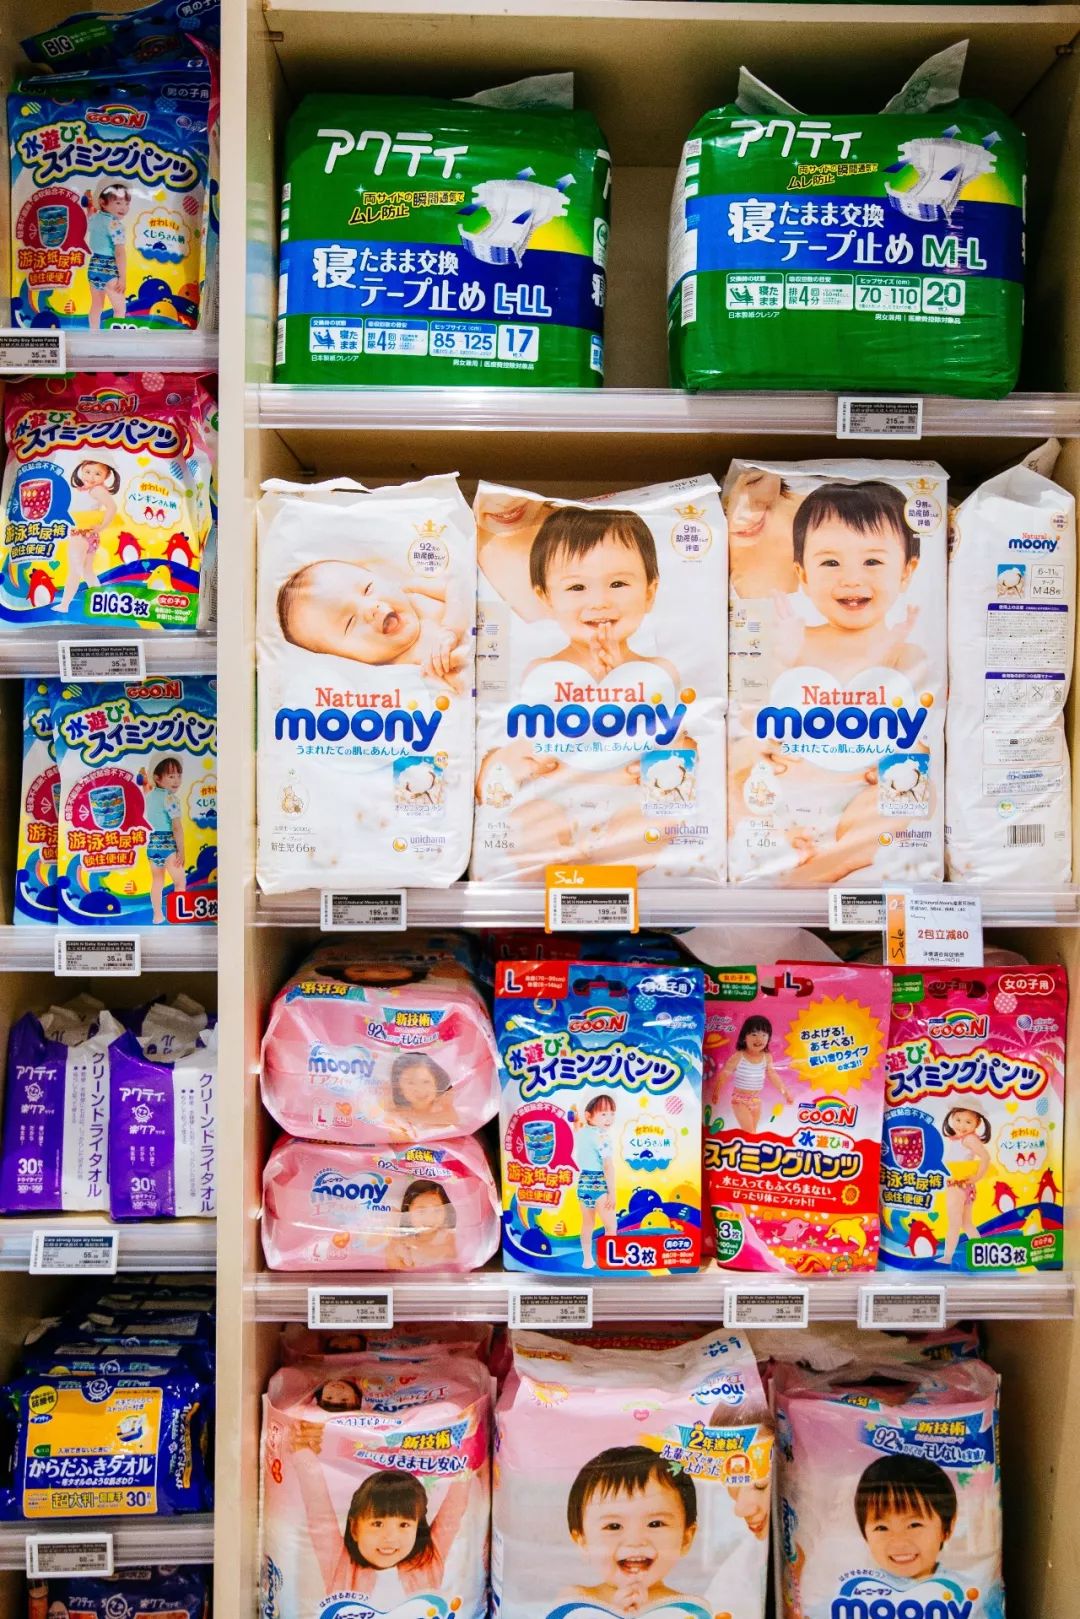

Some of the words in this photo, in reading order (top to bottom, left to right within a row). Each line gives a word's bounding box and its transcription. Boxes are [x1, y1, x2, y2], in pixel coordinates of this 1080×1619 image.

[730, 120, 864, 160] アクティ
[41, 145, 193, 183] スイミングパンツ
[316, 129, 469, 180] アクティ
[786, 174, 835, 190] ムレ防止
[348, 205, 411, 226] ムレ防止
[779, 231, 914, 265] テープ止め
[18, 249, 85, 270] 游泳纸尿裤
[359, 277, 486, 313] テープ止め
[926, 282, 962, 308] 20
[505, 327, 532, 354] 17
[23, 418, 178, 454] スイミングパンツ
[1008, 538, 1058, 552] moony
[315, 687, 401, 708] Natural
[554, 681, 646, 703] Natural
[802, 685, 886, 706] Natural
[275, 707, 444, 753] moony
[507, 702, 688, 746] moony
[756, 705, 930, 750] moony
[88, 713, 217, 759] スイミングパン
[296, 745, 410, 757] うまれたての肌にあんしん
[534, 742, 653, 753] うまれたての肌にあんしん
[782, 743, 895, 755] うまれたての肌にあんしん
[68, 829, 147, 852] 游泳纸尿裤
[665, 824, 709, 836] unicharm
[895, 829, 932, 839] unicharm
[554, 870, 585, 885] Sale
[891, 928, 905, 960] Sale
[917, 929, 969, 941] 2包立减80
[503, 970, 522, 993] L
[1003, 978, 1050, 992] 女の子用
[395, 1012, 432, 1027] 新技術
[799, 1025, 846, 1041] およげる!
[809, 1036, 855, 1052] あそべる!
[308, 1051, 376, 1078] moony
[808, 1046, 869, 1068] 使いきりタイプ
[887, 1042, 932, 1071] 遊び用
[16, 1065, 57, 1082] アクティ
[526, 1049, 675, 1092] スイミングパンツ
[890, 1053, 1041, 1098] スイミングパンツ
[119, 1087, 166, 1103] アクティ
[86, 1051, 106, 1198] クリーンドライタオル
[199, 1072, 216, 1213] クリーンドライタオル
[798, 1132, 850, 1149] 水遊び用
[704, 1144, 861, 1180] スイミングパンツ
[312, 1183, 389, 1204] moony
[721, 1176, 832, 1197] 水に入ってもふくらまない
[372, 1203, 391, 1212] man
[731, 1191, 816, 1207] ぴったり体にフィット!!
[916, 1420, 966, 1436] 新技術
[401, 1429, 452, 1450] 新技術
[29, 1457, 153, 1479] からだふきタオル
